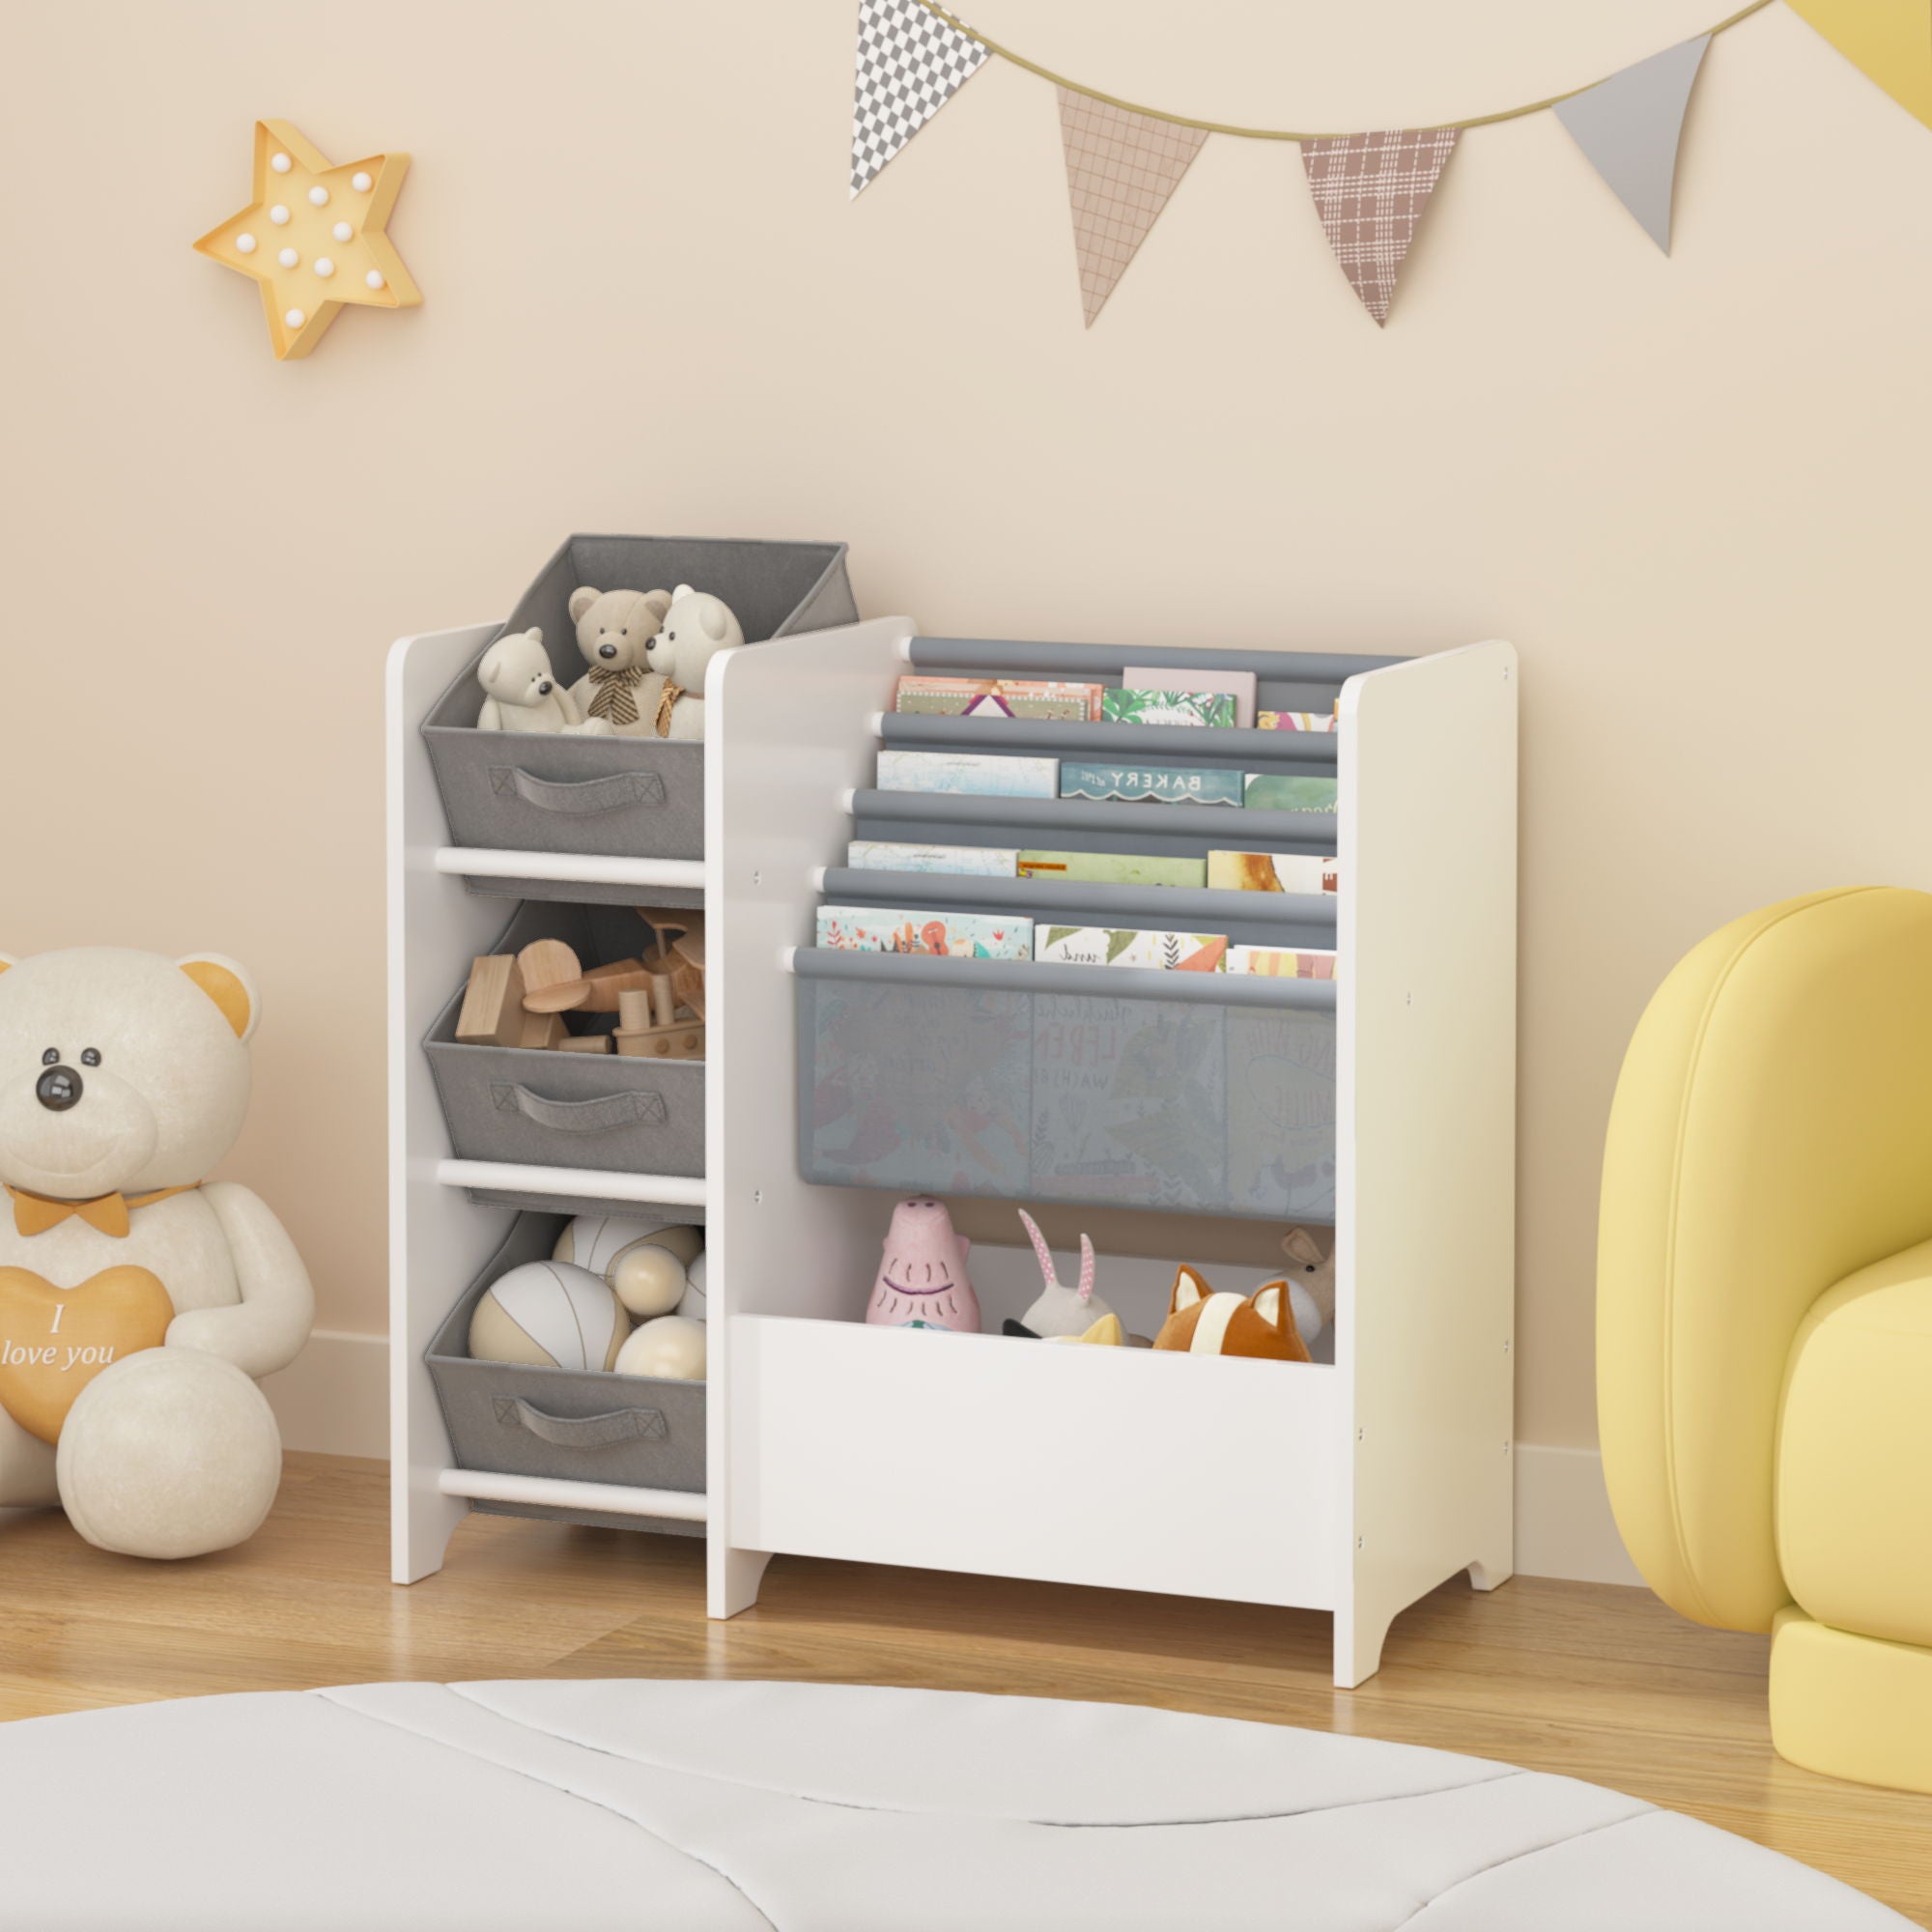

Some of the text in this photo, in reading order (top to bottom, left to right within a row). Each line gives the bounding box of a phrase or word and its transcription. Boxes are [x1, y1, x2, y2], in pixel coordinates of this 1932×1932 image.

[50, 1304, 66, 1333] I
[2, 1340, 114, 1372] love you
